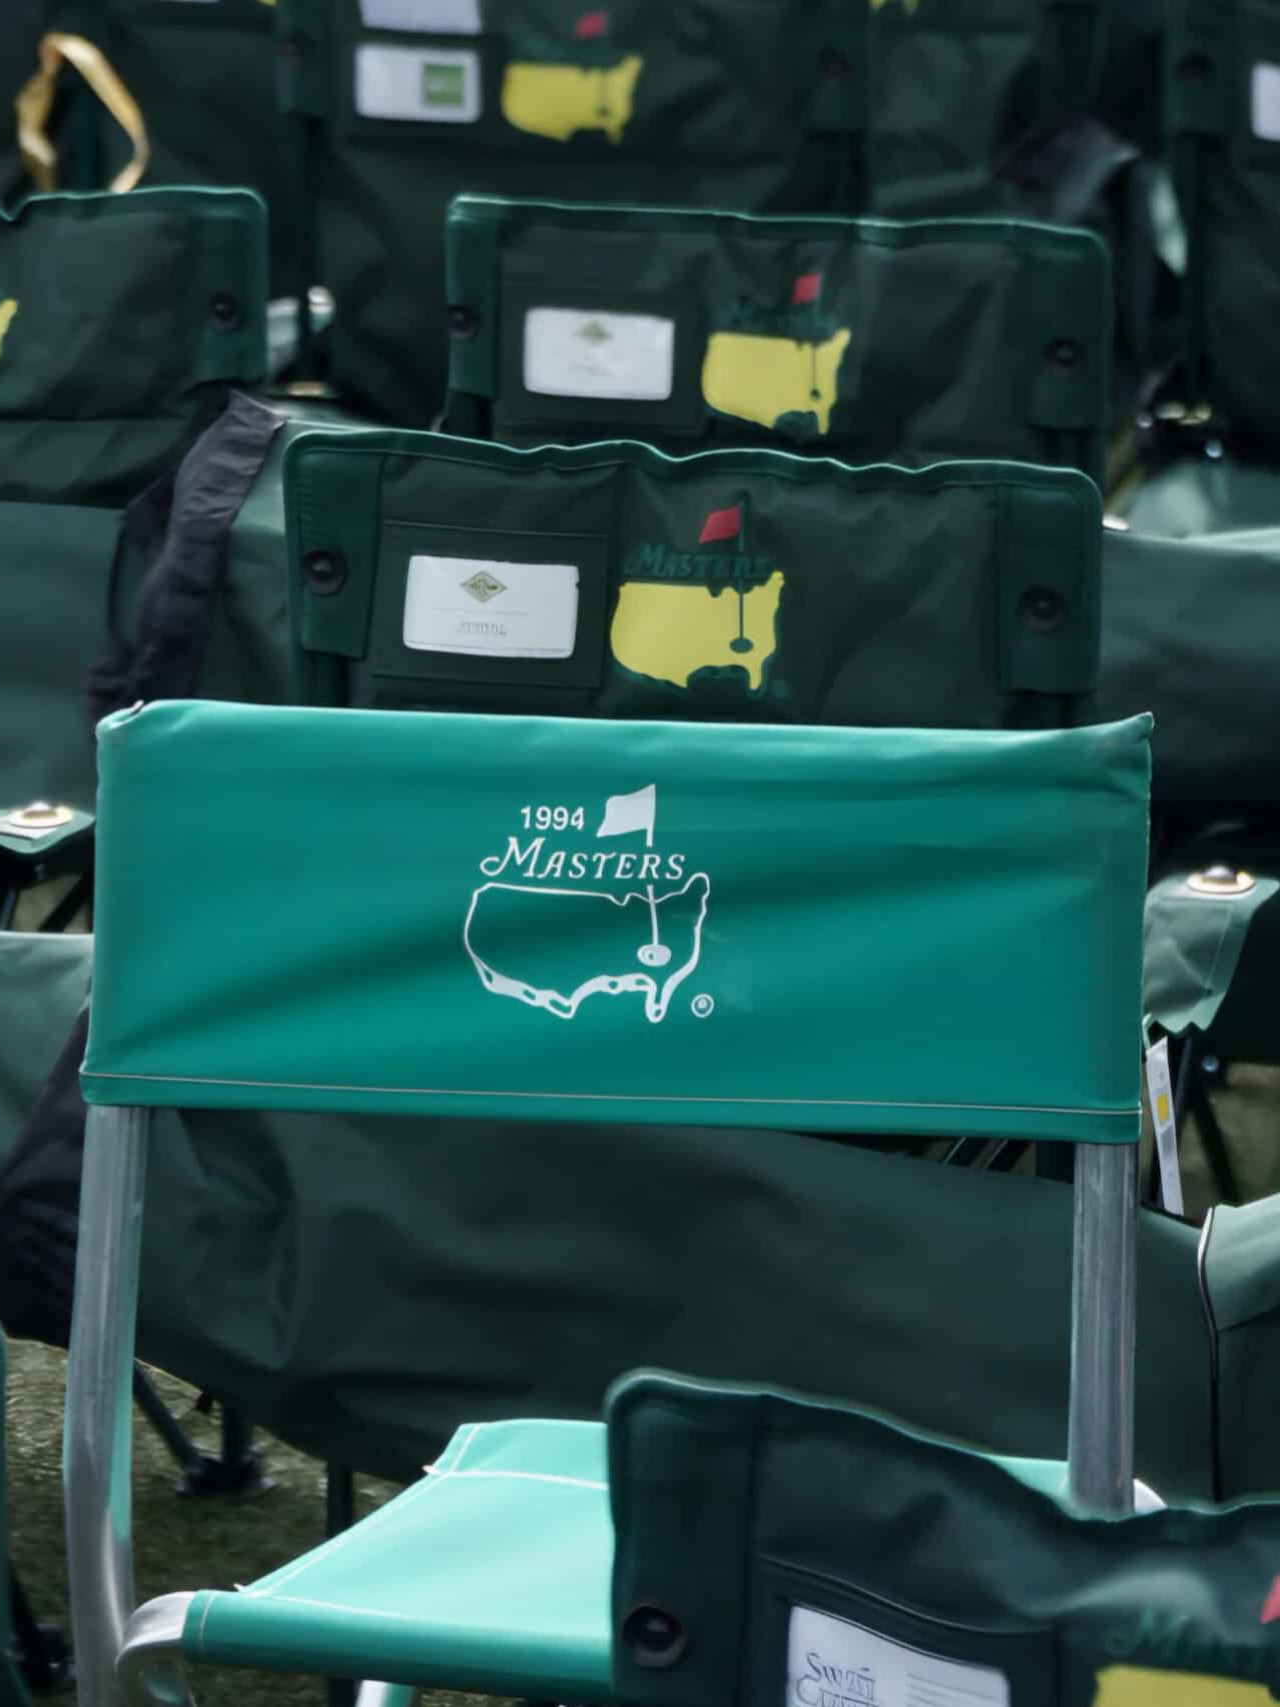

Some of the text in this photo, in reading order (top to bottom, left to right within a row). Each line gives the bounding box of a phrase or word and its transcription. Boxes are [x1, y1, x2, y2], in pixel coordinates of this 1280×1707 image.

[625, 542, 773, 579] MASTERS
[520, 806, 585, 831] 1994
[479, 837, 686, 880] MASTERS
